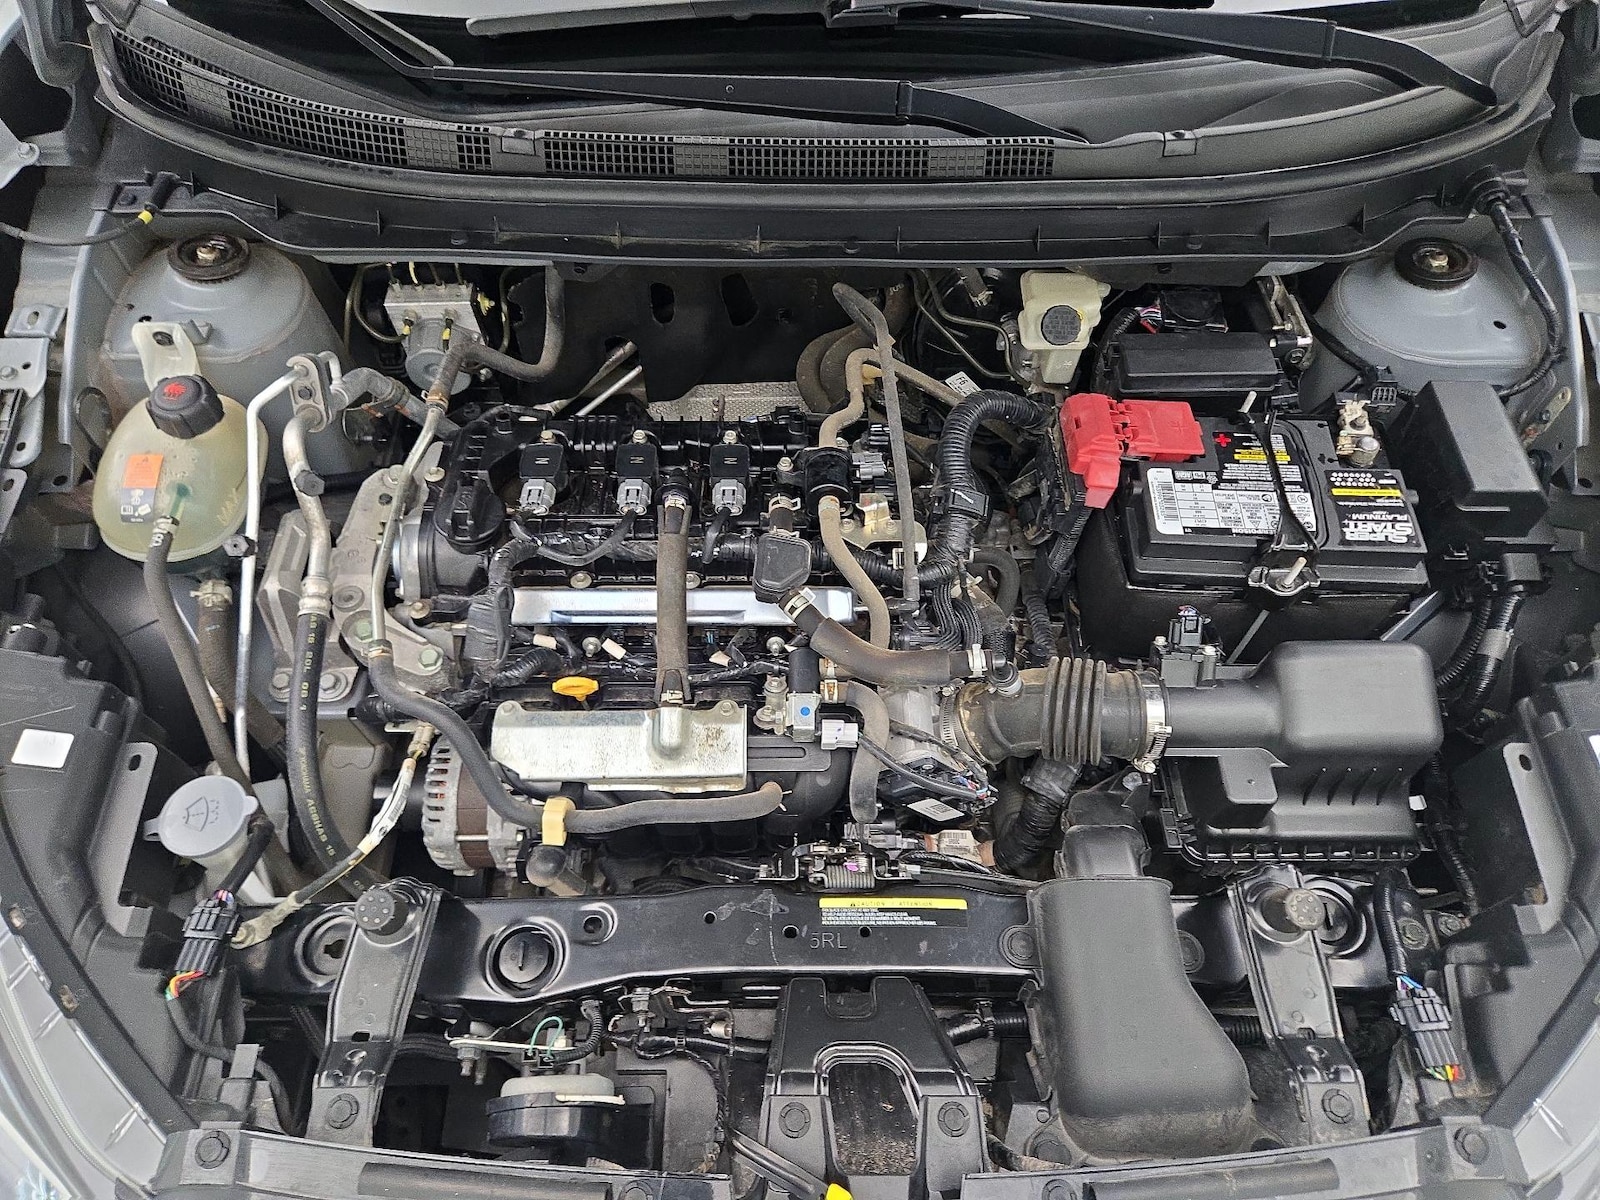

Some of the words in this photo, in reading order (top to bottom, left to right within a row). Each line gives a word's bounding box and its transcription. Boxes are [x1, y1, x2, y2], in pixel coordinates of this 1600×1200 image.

[1351, 513, 1408, 521] PLATINUM
[1345, 530, 1408, 543] SUPER
[809, 932, 848, 949] 5RL
